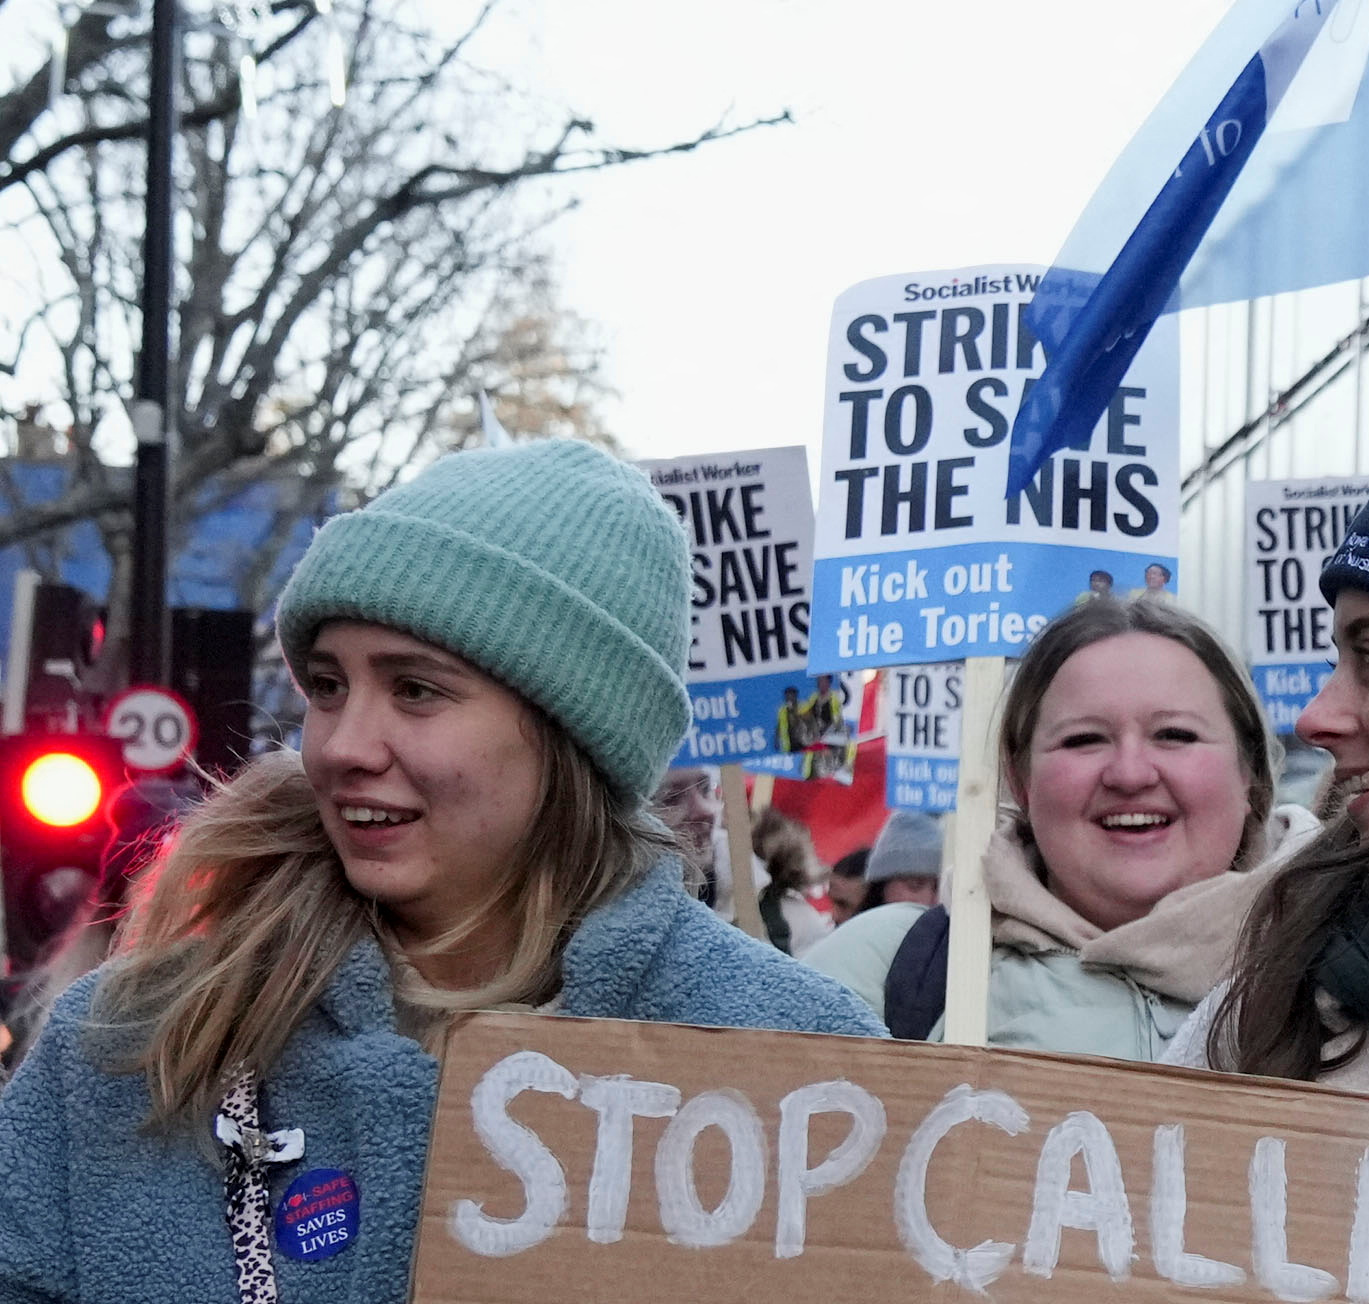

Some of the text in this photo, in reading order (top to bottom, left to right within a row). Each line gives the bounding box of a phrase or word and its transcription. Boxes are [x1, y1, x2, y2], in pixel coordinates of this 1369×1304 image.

[904, 275, 1013, 302] Socialist
[839, 385, 933, 461] TO
[834, 456, 1160, 540] THE NHS
[840, 554, 1013, 608] Kick out
[1256, 557, 1305, 603] TO
[720, 601, 810, 668] NHS
[836, 601, 1049, 659] the Tories
[1259, 607, 1332, 654] THE
[693, 688, 740, 721] out
[896, 672, 931, 709] TO
[119, 711, 182, 748] 20
[895, 711, 949, 748] THE
[448, 1050, 887, 1259] STOP
[311, 1175, 350, 1197] SAFE
[296, 1208, 346, 1237] SAVES
[301, 1227, 349, 1254] LIVES
